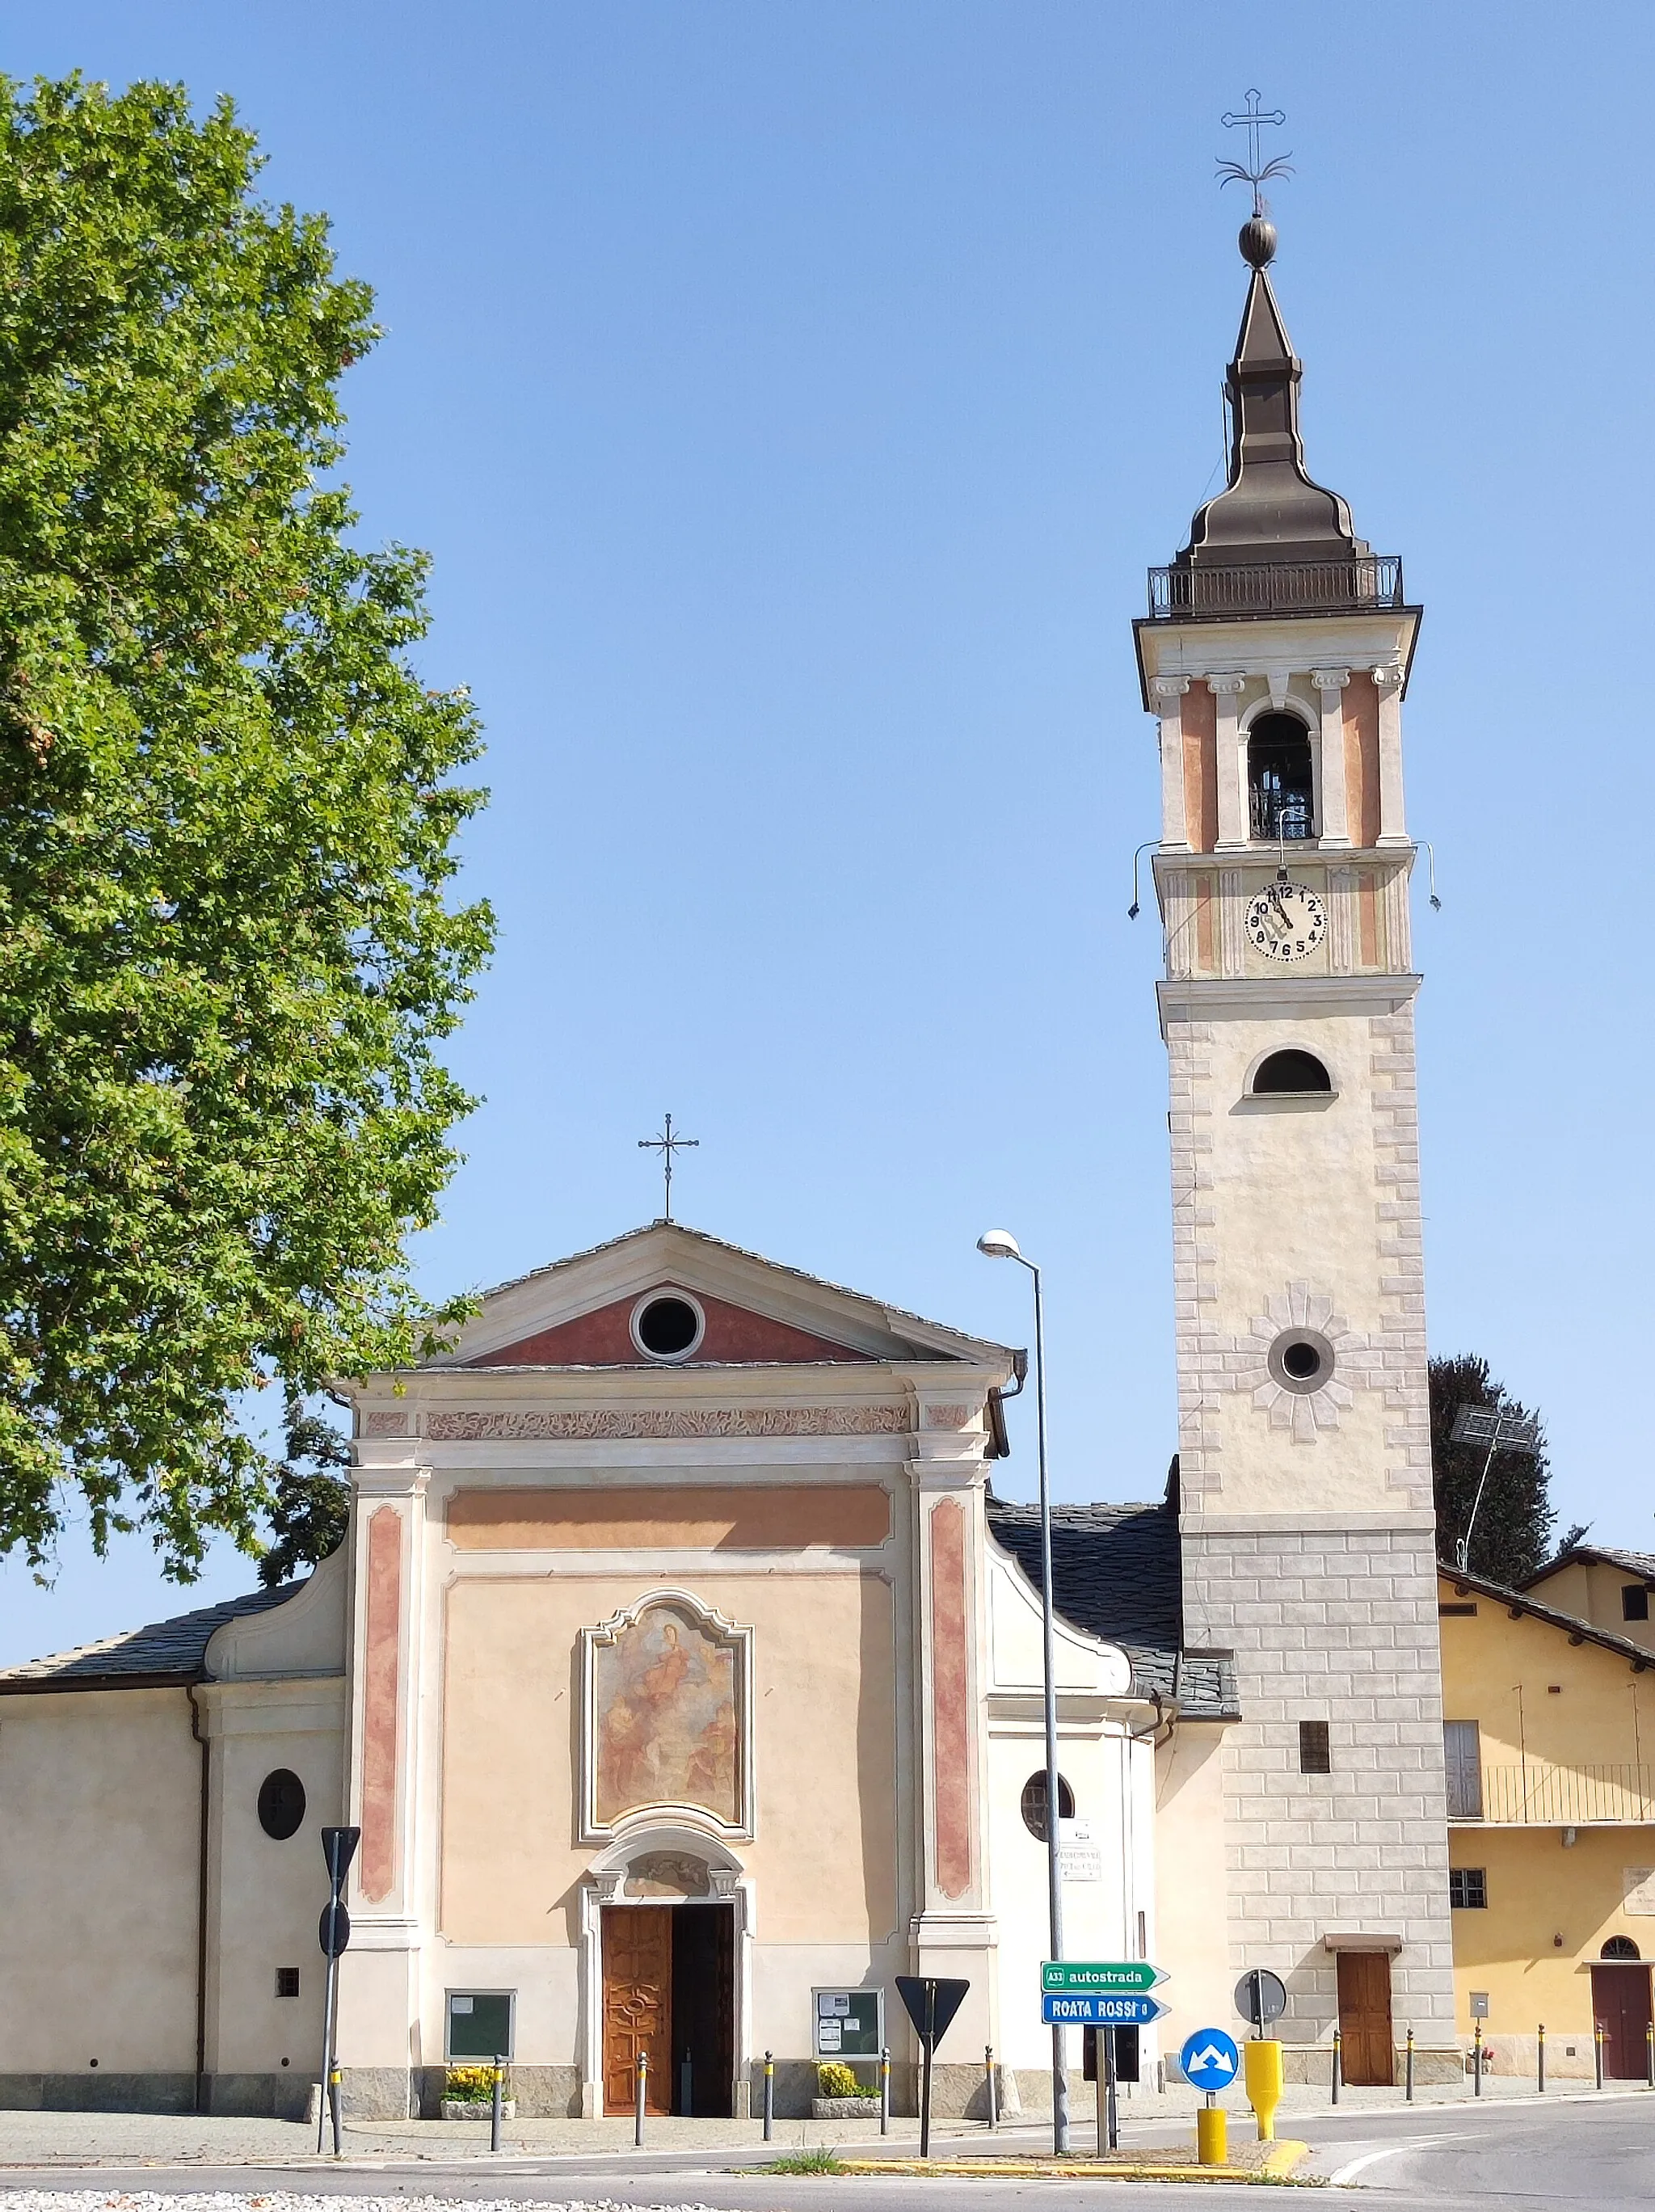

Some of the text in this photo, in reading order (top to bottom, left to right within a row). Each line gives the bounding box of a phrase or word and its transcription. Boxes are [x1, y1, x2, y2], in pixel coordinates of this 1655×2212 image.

[1279, 887, 1293, 899] 12
[1299, 891, 1304, 903] 1
[1254, 902, 1268, 915] 10
[1308, 900, 1316, 912] 2
[1250, 916, 1259, 928] 9
[1313, 915, 1322, 926] 3
[1256, 930, 1265, 943] 8
[1308, 929, 1316, 942] 4
[1270, 941, 1278, 954] 7
[1282, 944, 1291, 955] 6
[1296, 941, 1304, 952] 5
[1047, 1970, 1142, 1983] A33 autostrada
[1052, 2000, 1092, 2017] ROATA
[1098, 2000, 1136, 2017] ROSSI
